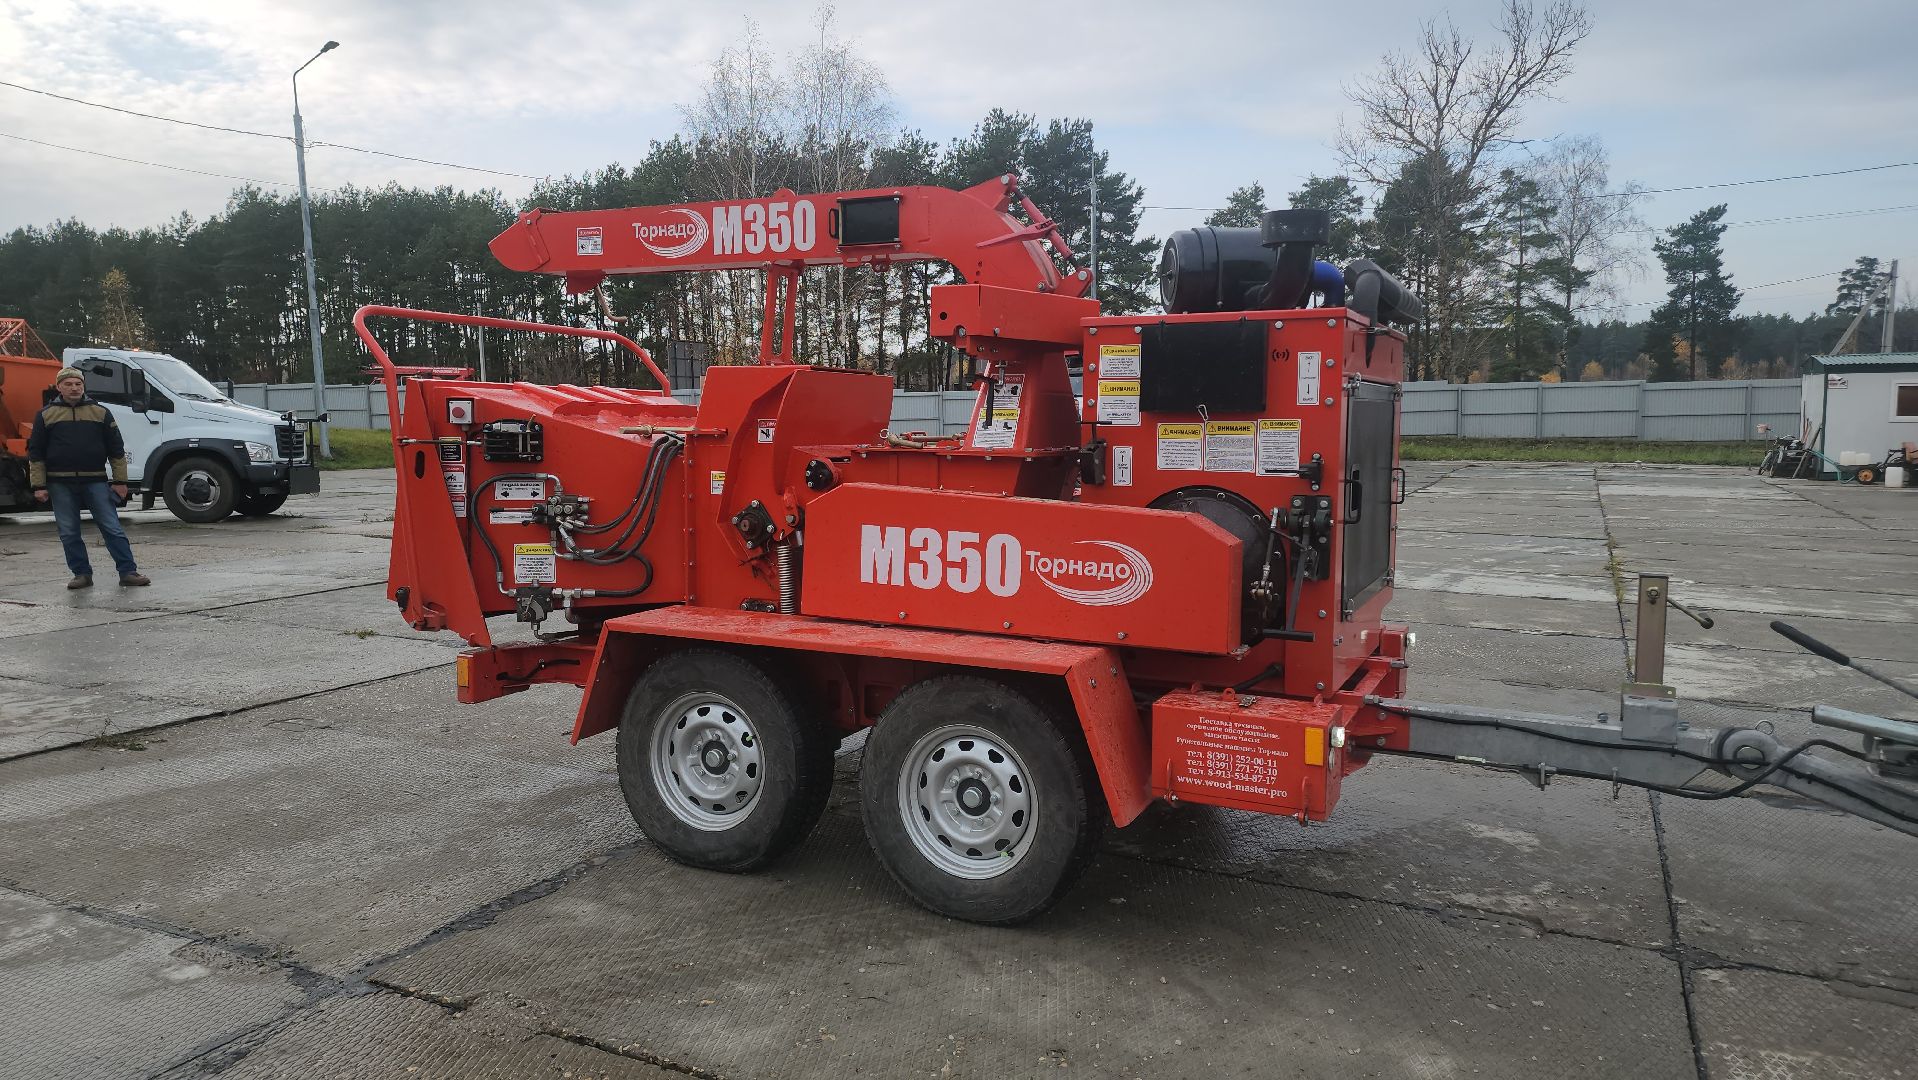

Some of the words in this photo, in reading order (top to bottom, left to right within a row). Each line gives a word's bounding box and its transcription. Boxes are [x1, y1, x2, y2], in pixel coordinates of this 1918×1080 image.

[632, 222, 697, 241] Торнадо
[1026, 550, 1131, 581] Торнадо
[1186, 750, 1205, 759] тел.
[1206, 751, 1233, 763] 8(391)
[1235, 754, 1277, 767] 252-00-11
[1186, 759, 1205, 767] тел.
[1206, 760, 1233, 772] 8(391)
[1235, 763, 1278, 776] 271-70-10
[1188, 767, 1206, 776] тел.
[1207, 768, 1277, 785] 8-913-534-87-17
[1177, 775, 1288, 798] www.wood-master.pro
